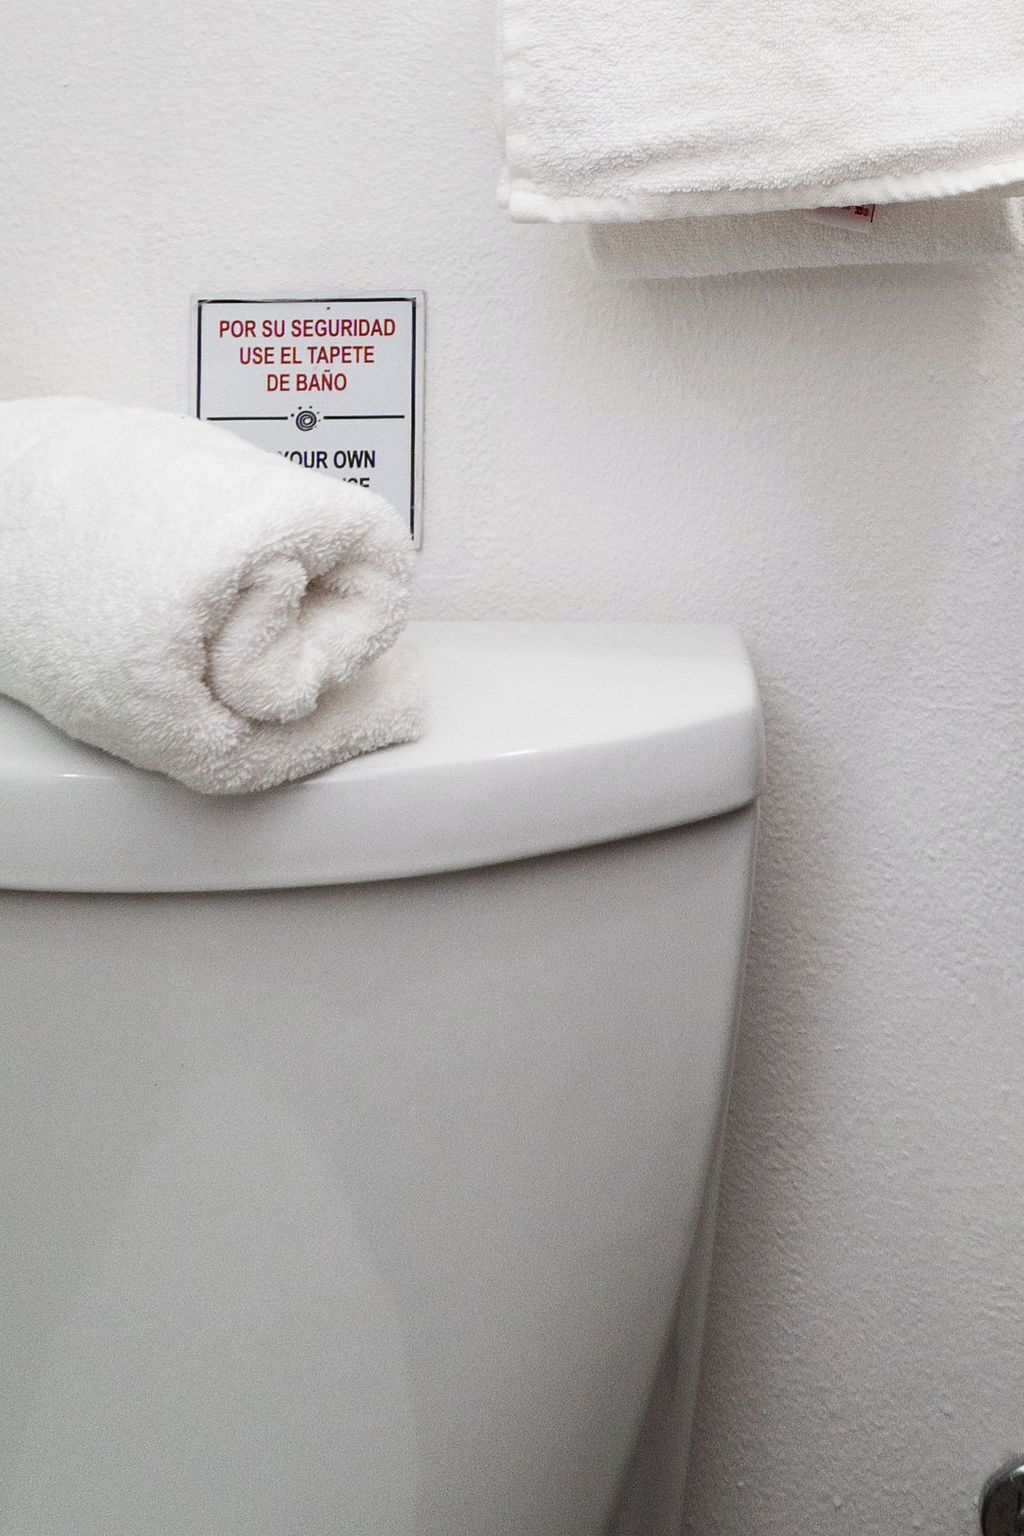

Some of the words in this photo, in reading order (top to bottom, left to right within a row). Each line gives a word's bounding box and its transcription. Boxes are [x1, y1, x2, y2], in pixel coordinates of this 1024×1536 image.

[219, 320, 256, 338] POR
[262, 319, 286, 337] SU
[291, 318, 396, 337] SEGURIDAD
[240, 347, 274, 365] USE
[280, 346, 302, 364] EL
[308, 346, 374, 364] TAPETE
[266, 374, 290, 392] DE
[296, 369, 348, 392] BAÑO
[334, 450, 376, 468] OWN
